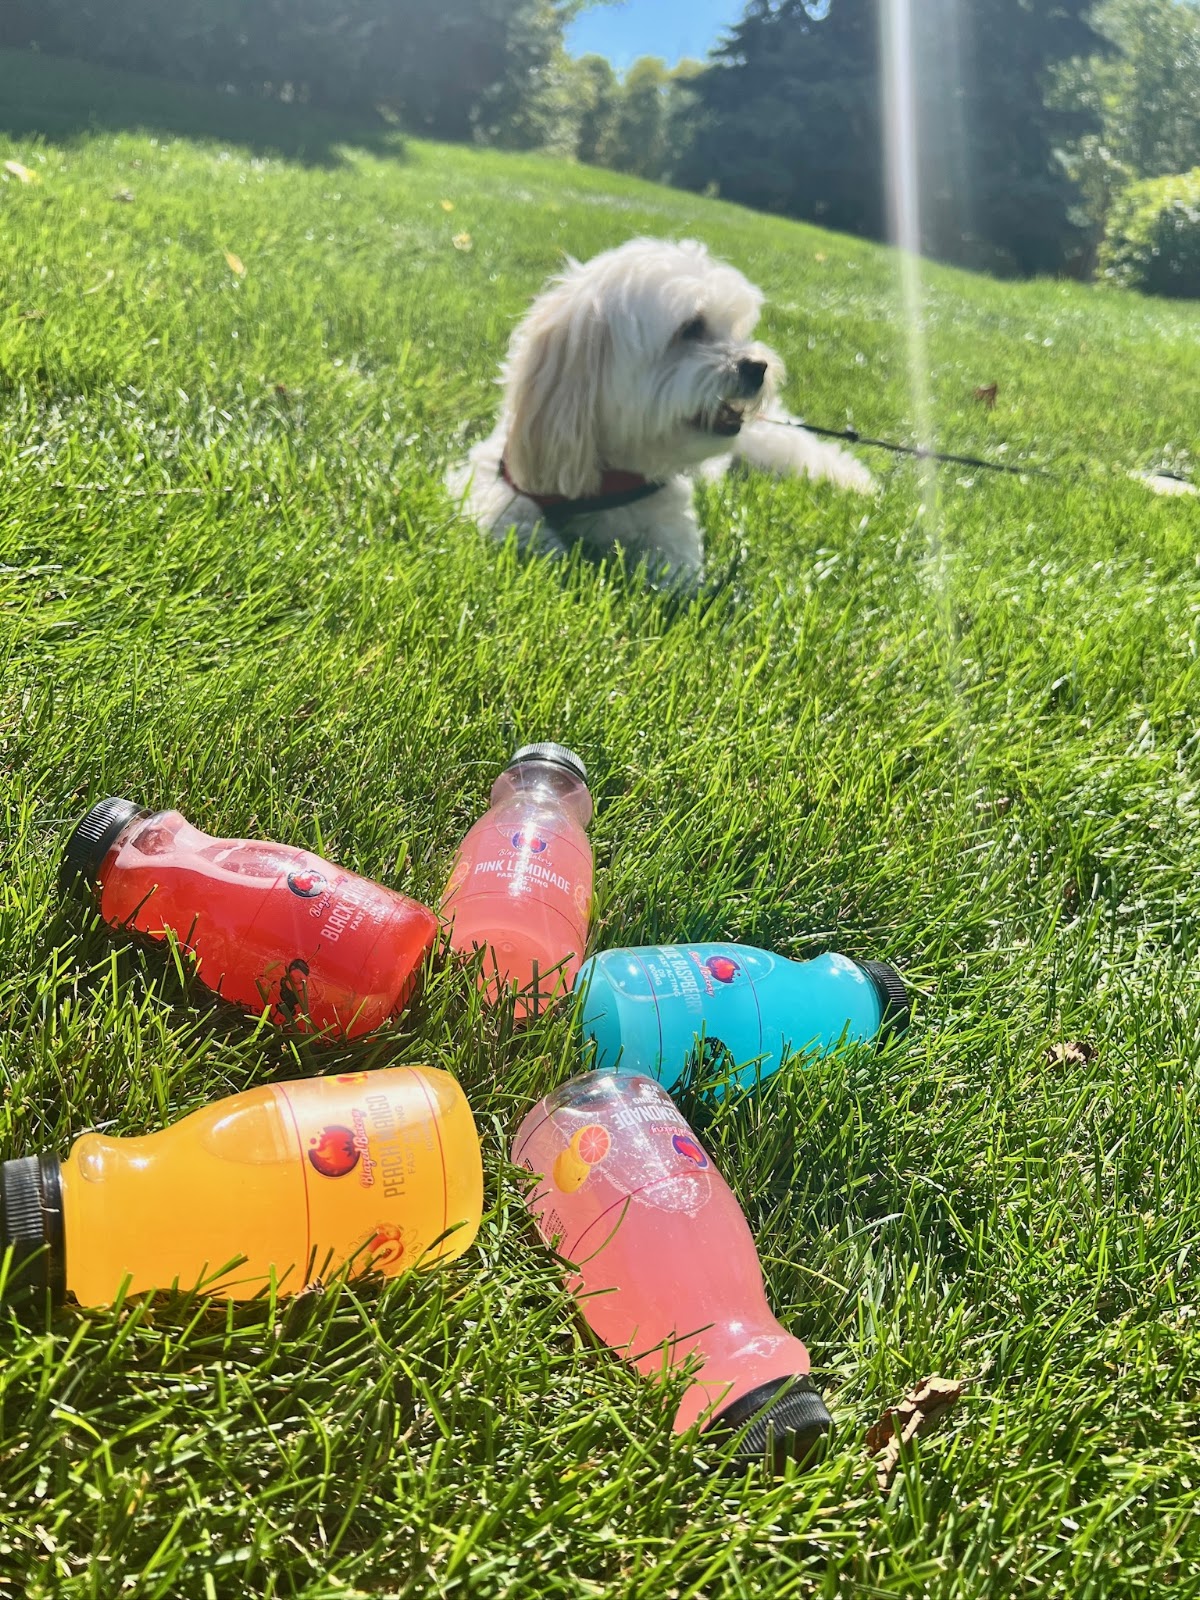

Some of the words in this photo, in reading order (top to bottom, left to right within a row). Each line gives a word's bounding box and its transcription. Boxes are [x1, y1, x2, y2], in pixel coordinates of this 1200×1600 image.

[475, 859, 505, 875] PINK
[507, 860, 571, 895] LEMONADE
[321, 901, 354, 942] BLACK
[350, 910, 367, 931] FAST
[666, 968, 681, 998] ACTING
[670, 959, 703, 1014] RASPBERRY
[352, 1107, 369, 1145] Bakery
[366, 1094, 397, 1143] MANGO
[356, 1147, 377, 1188] Blazed
[380, 1145, 405, 1198] PEACH
